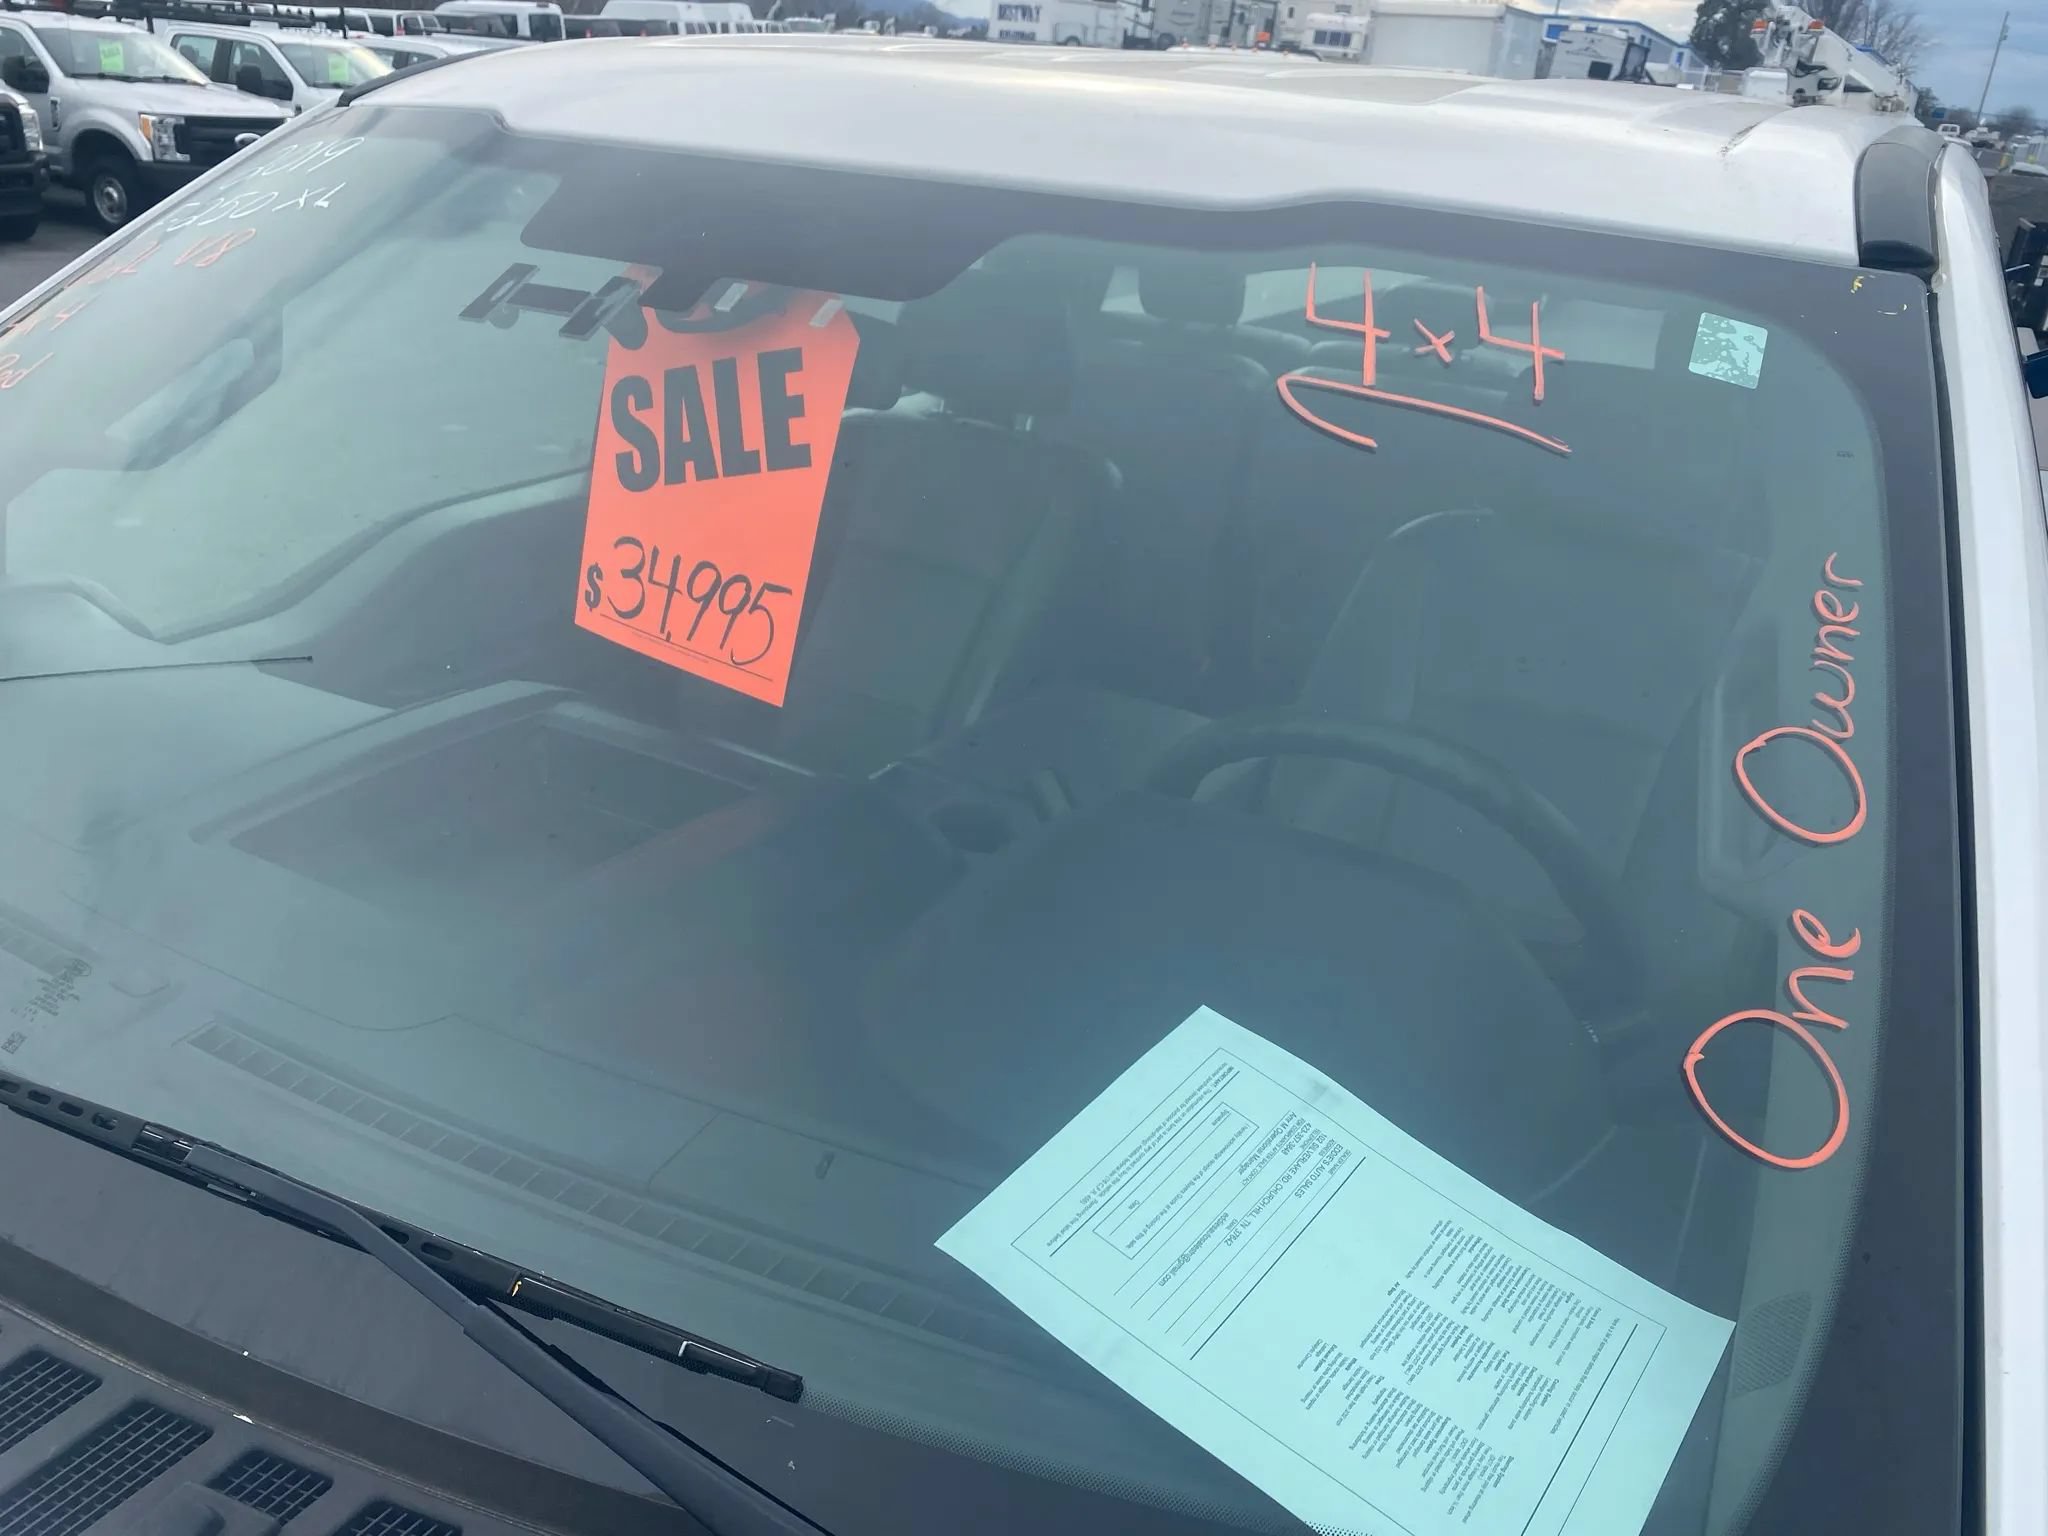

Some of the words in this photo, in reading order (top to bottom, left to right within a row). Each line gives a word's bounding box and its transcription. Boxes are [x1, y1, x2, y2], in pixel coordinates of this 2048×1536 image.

[610, 346, 812, 493] SALE
[1735, 551, 1867, 844] Owner
[1683, 908, 1862, 1170] One
[1255, 1127, 1283, 1154] Operational
[1314, 1132, 1328, 1144] 102
[1235, 1152, 1259, 1175] Manager
[1287, 1141, 1319, 1175] SILVERLAKE
[1321, 1143, 1343, 1166] EDDIE'S
[1308, 1163, 1326, 1181] AUTO
[1258, 1182, 1283, 1207] CHURCH
[1293, 1178, 1313, 1198] SALES
[1239, 1218, 1251, 1229] TN
[1223, 1228, 1242, 1246] 37642
